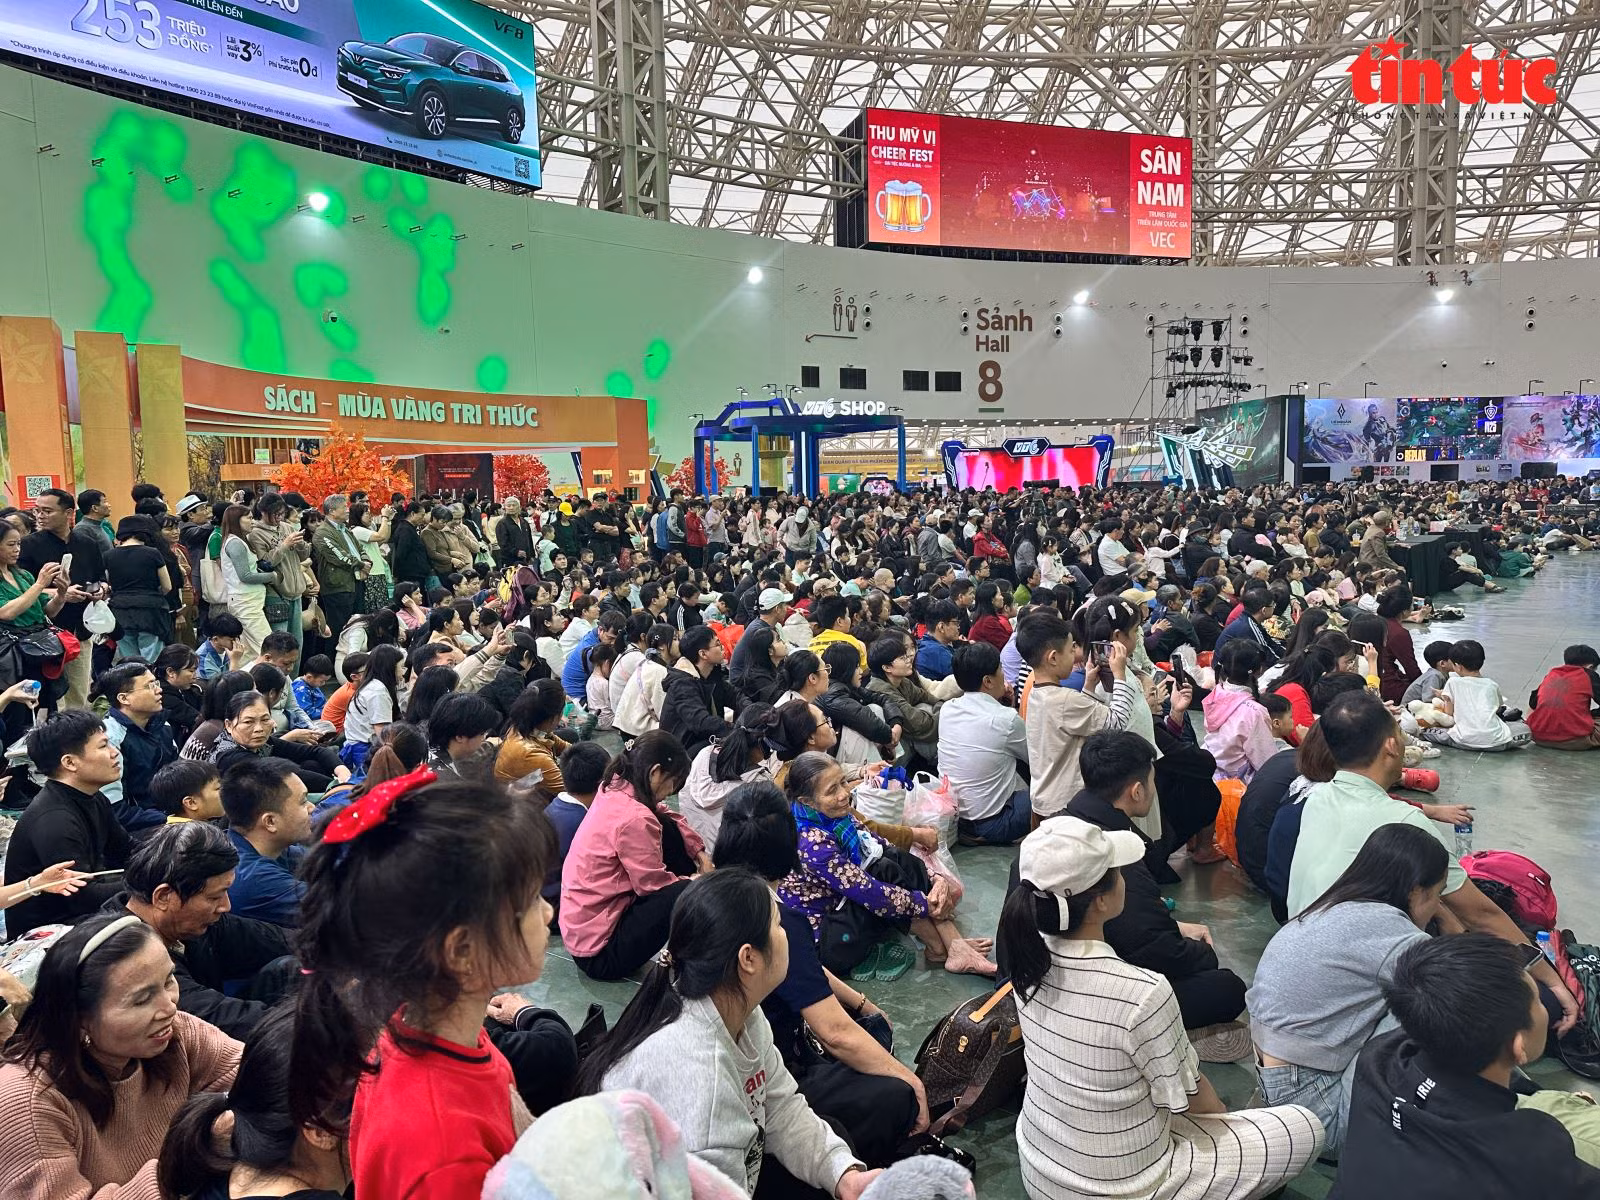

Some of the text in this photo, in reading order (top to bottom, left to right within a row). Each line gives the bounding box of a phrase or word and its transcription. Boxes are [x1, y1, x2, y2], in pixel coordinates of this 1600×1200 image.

[207, 0, 224, 13] LÊN
[225, 6, 243, 19] ĐẾN
[71, 0, 163, 50] 253
[166, 16, 206, 37] TRIỆU
[868, 124, 937, 147] THU MỸ VỊ
[871, 145, 934, 163] CHEER FEST
[1140, 145, 1181, 176] SÂN
[1137, 181, 1184, 207] NAM
[1148, 211, 1165, 219] TRUNG
[1149, 231, 1175, 248] VEC
[976, 307, 1033, 331] Sảnh
[975, 335, 1010, 352] Hall
[978, 360, 1003, 403] 8
[264, 383, 316, 413] SÁCH
[338, 391, 387, 418] MÙA
[390, 395, 445, 422] VÀNG
[450, 403, 482, 425] TRI
[486, 403, 538, 427] THỨC
[840, 400, 886, 416] SHOP
[1416, 1077, 1436, 1100] IRIE
